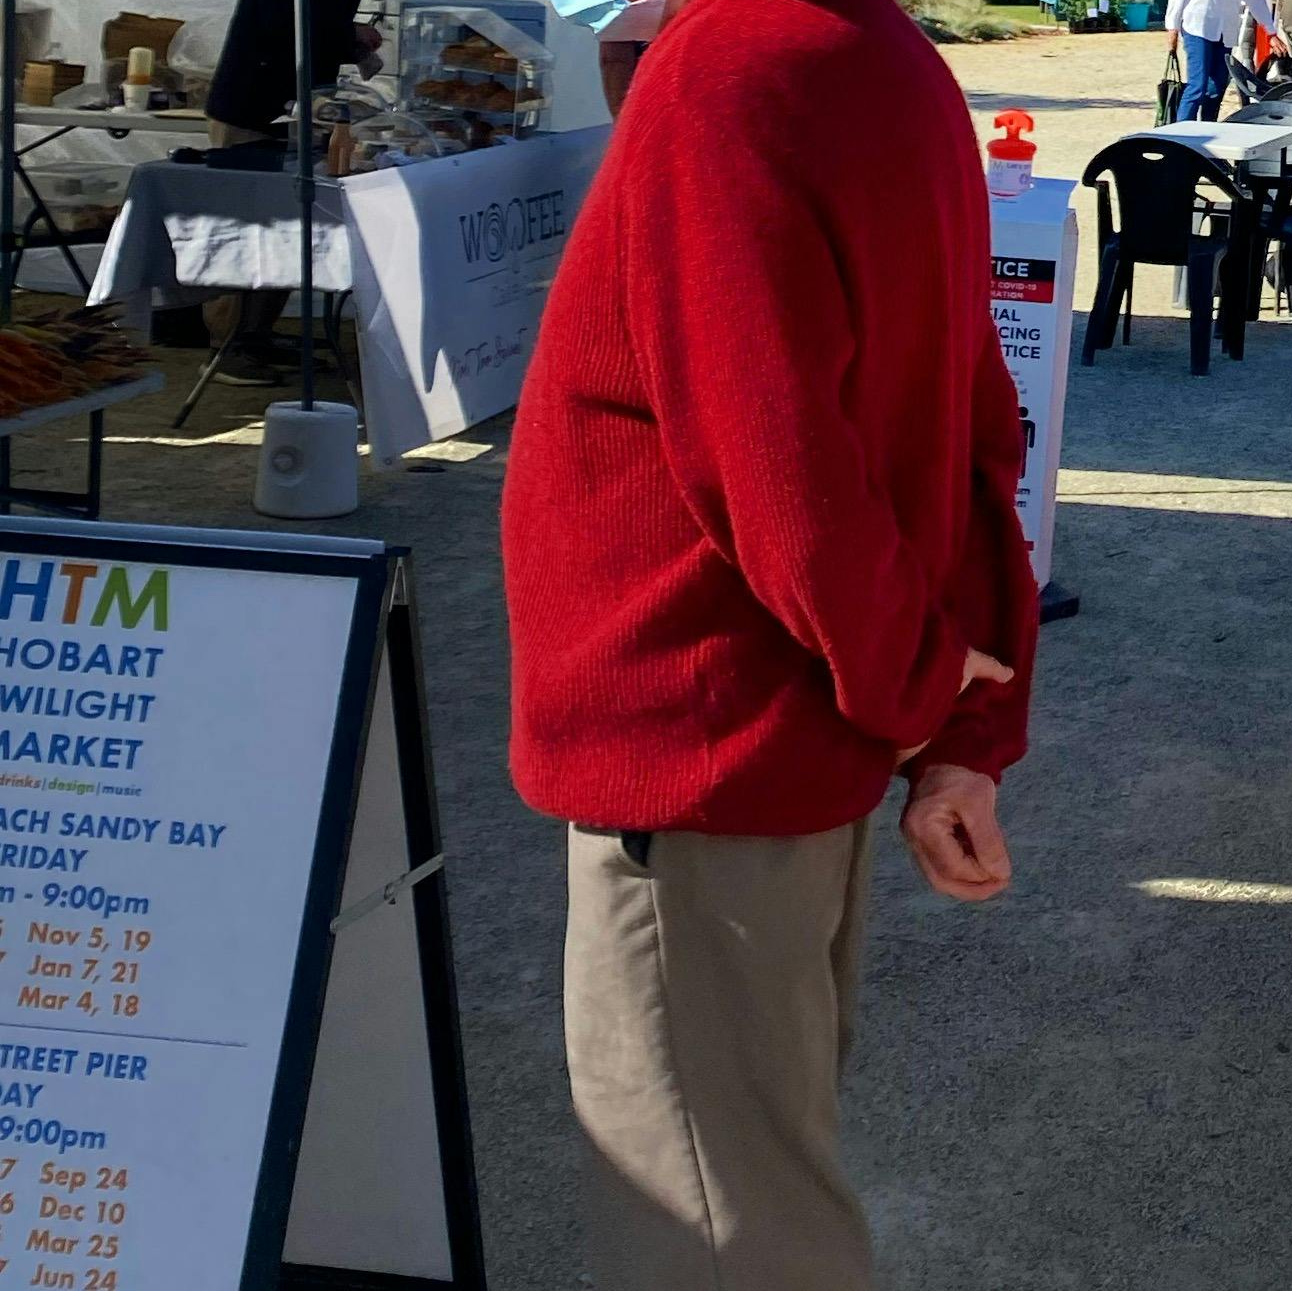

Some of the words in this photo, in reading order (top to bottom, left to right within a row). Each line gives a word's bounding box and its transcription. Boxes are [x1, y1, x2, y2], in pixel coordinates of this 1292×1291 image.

[998, 281, 1037, 291] COVID-19
[992, 308, 1021, 322] IAL
[999, 326, 1041, 341] CING
[0, 559, 169, 632] HTM
[59, 812, 161, 843] SANDY
[168, 820, 227, 848] BAY
[0, 842, 89, 873] RIDAY
[42, 882, 150, 919] 9:00pm
[27, 921, 81, 946] Nov
[87, 927, 109, 953] 5,
[124, 930, 151, 952] 19
[27, 954, 73, 978] Jan
[81, 958, 101, 984] 7,
[110, 961, 138, 984] 21
[17, 985, 70, 1010] Mar
[76, 991, 99, 1017] 4,
[113, 994, 140, 1017] 18
[85, 1052, 148, 1081] PIER
[0, 1082, 44, 1108] AY
[39, 1161, 87, 1194] Sep
[95, 1167, 128, 1191] 24
[39, 1196, 86, 1222] Dec
[97, 1201, 126, 1225] 10
[25, 1229, 79, 1255] Mar
[86, 1234, 119, 1260] 25
[30, 1263, 75, 1289] Jun
[84, 1269, 118, 1291] 24
